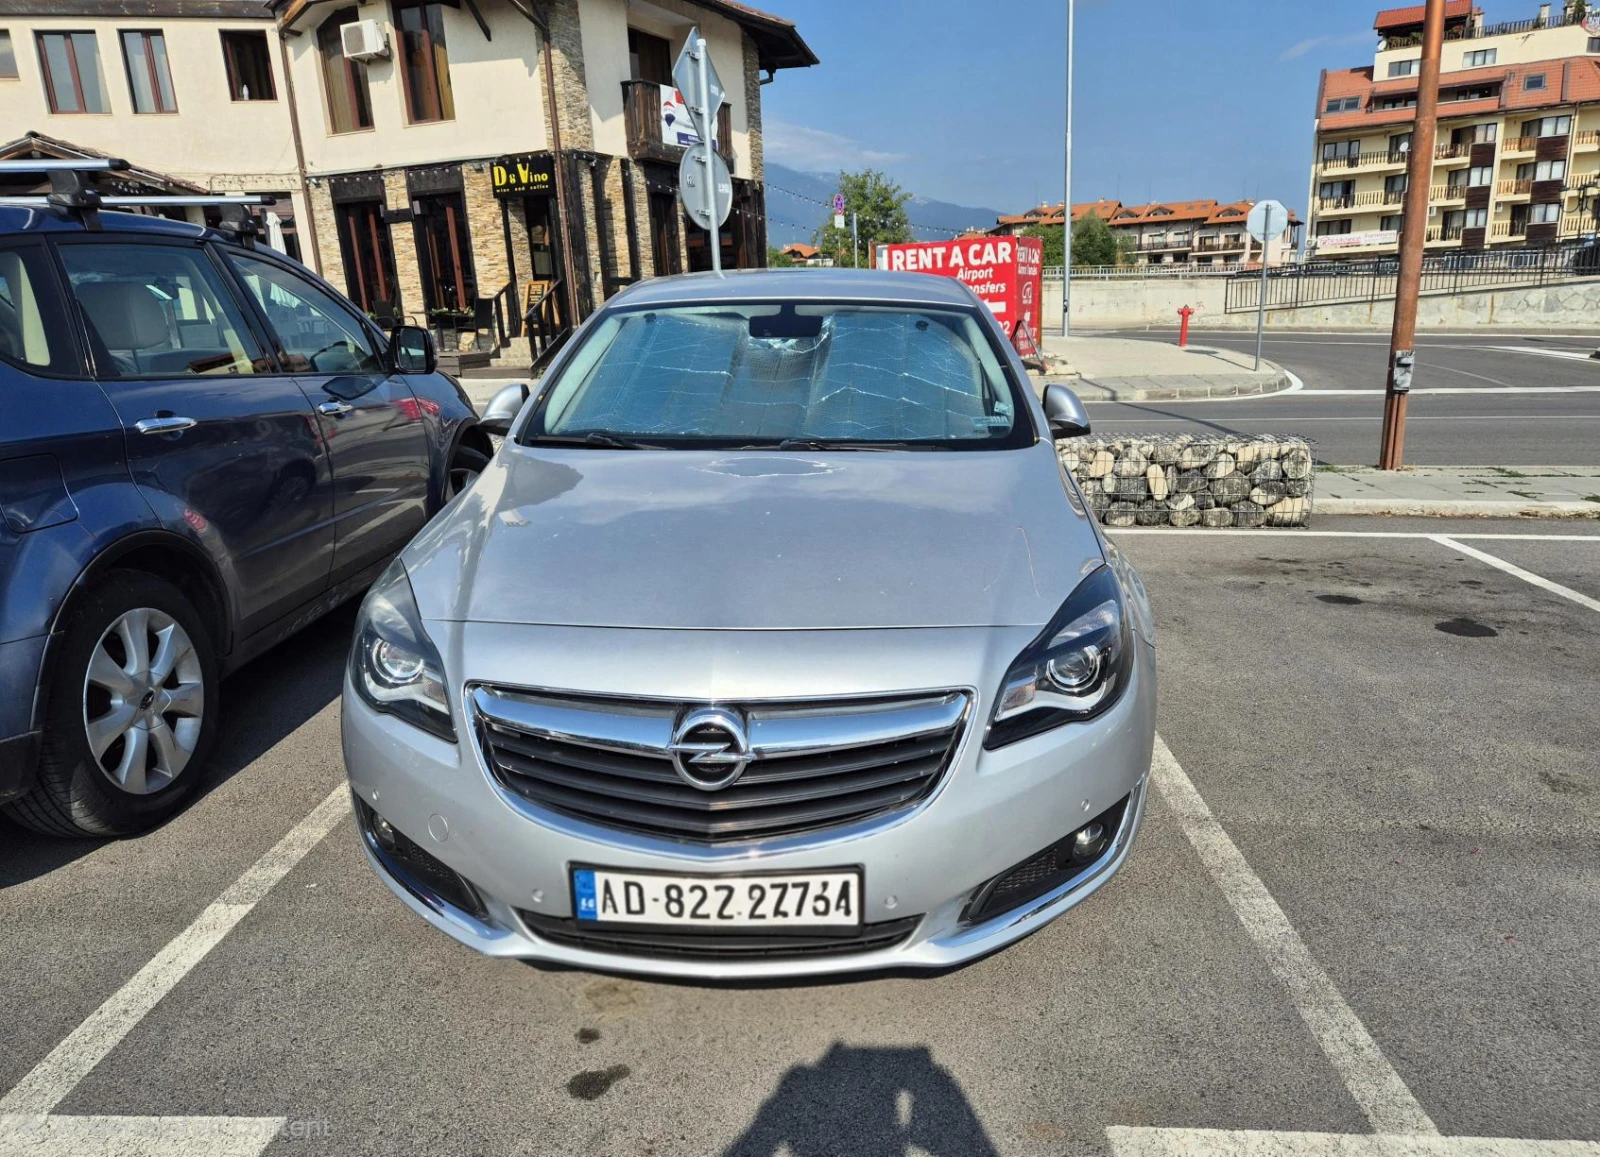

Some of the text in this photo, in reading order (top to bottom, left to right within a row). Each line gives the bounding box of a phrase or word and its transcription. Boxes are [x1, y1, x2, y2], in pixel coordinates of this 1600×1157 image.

[517, 163, 548, 183] Vino
[891, 241, 1012, 271] RENT A CAR
[957, 267, 994, 282] Airport
